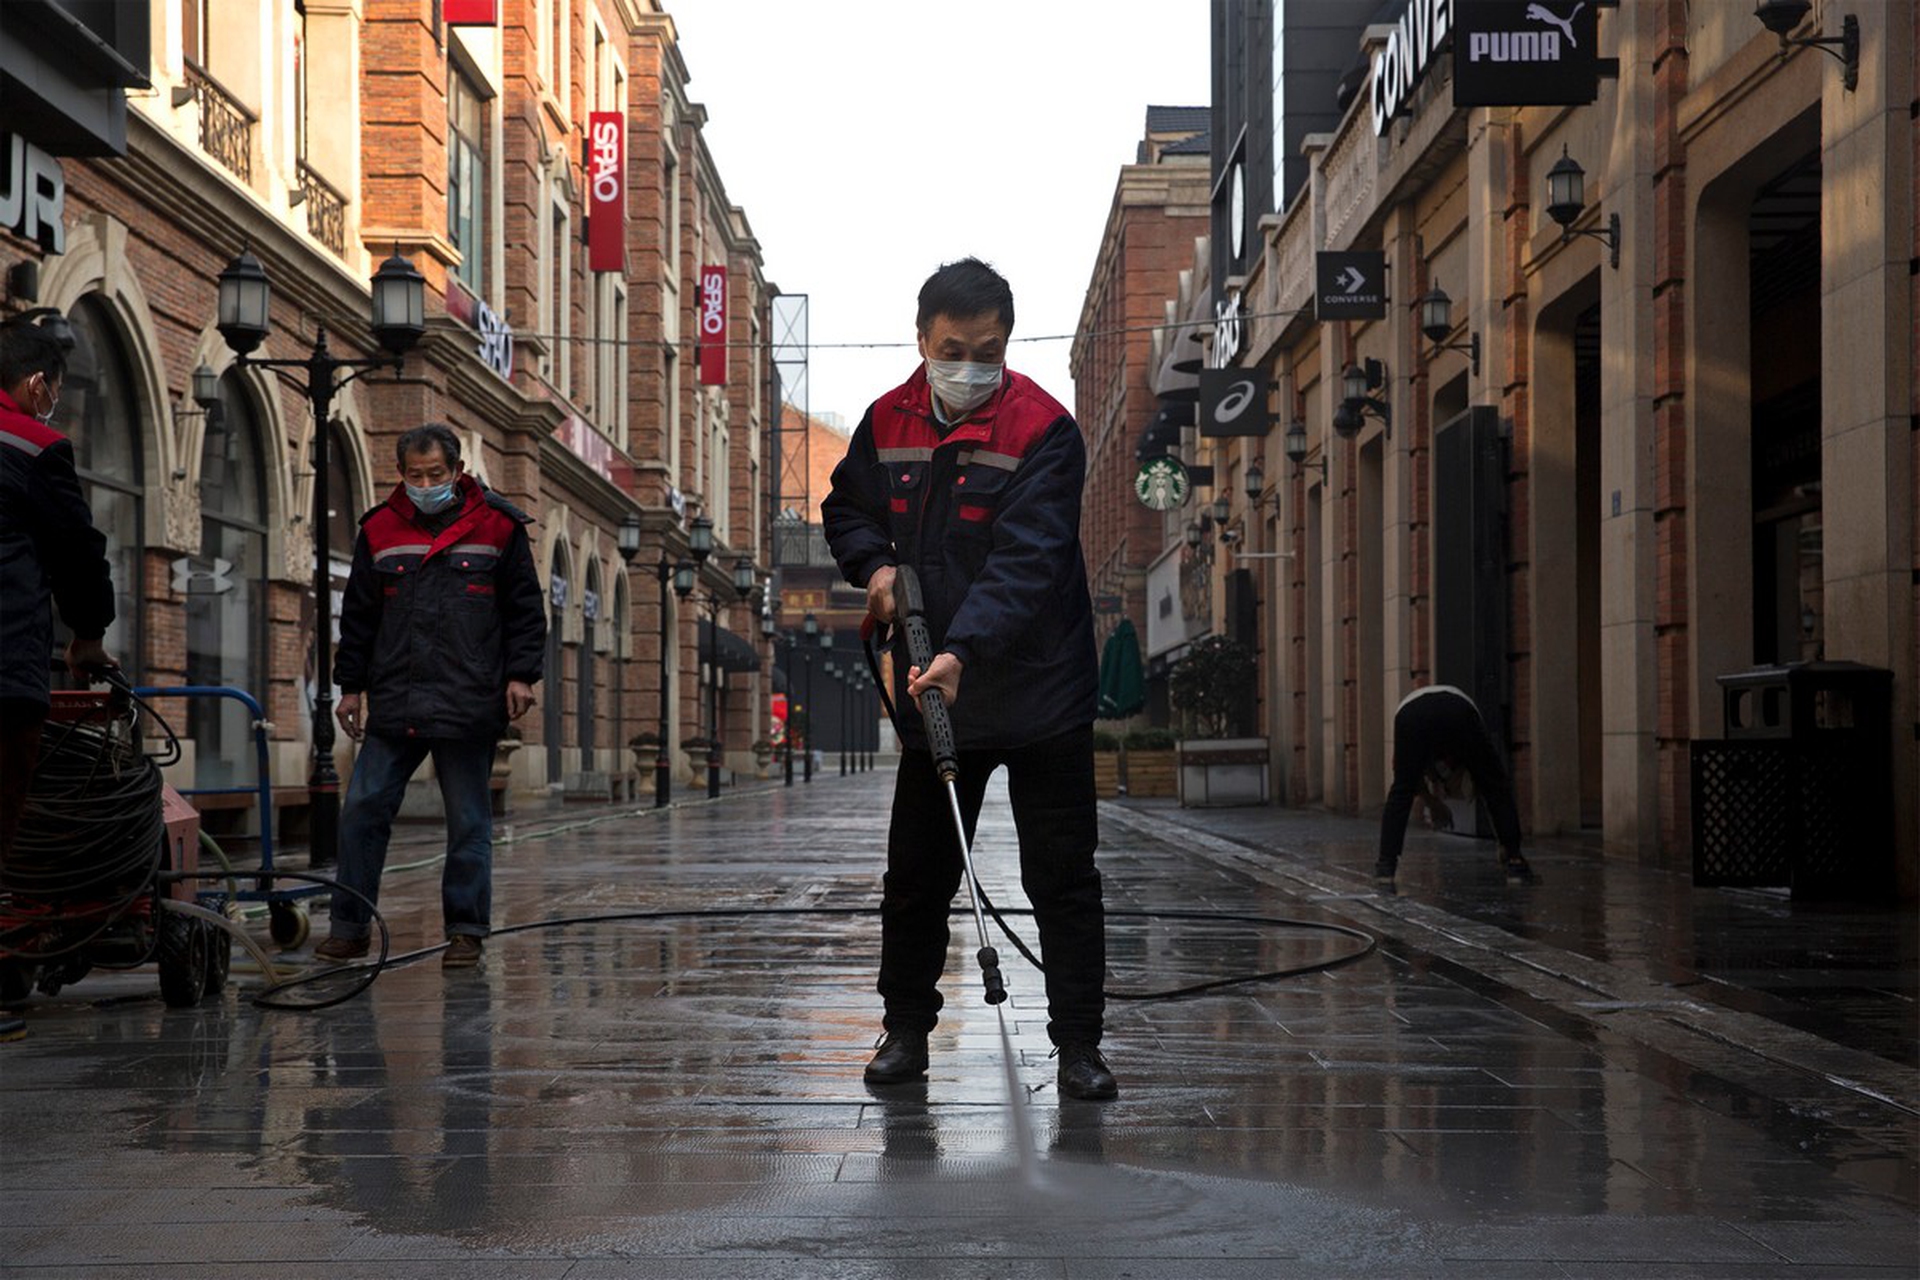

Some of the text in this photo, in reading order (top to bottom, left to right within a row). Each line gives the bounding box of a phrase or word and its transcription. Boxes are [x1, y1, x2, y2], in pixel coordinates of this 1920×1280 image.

[1470, 31, 1560, 62] PUMA
[593, 121, 619, 203] SPAO
[703, 273, 723, 334] SPAO
[1324, 295, 1378, 304] CONVERSE
